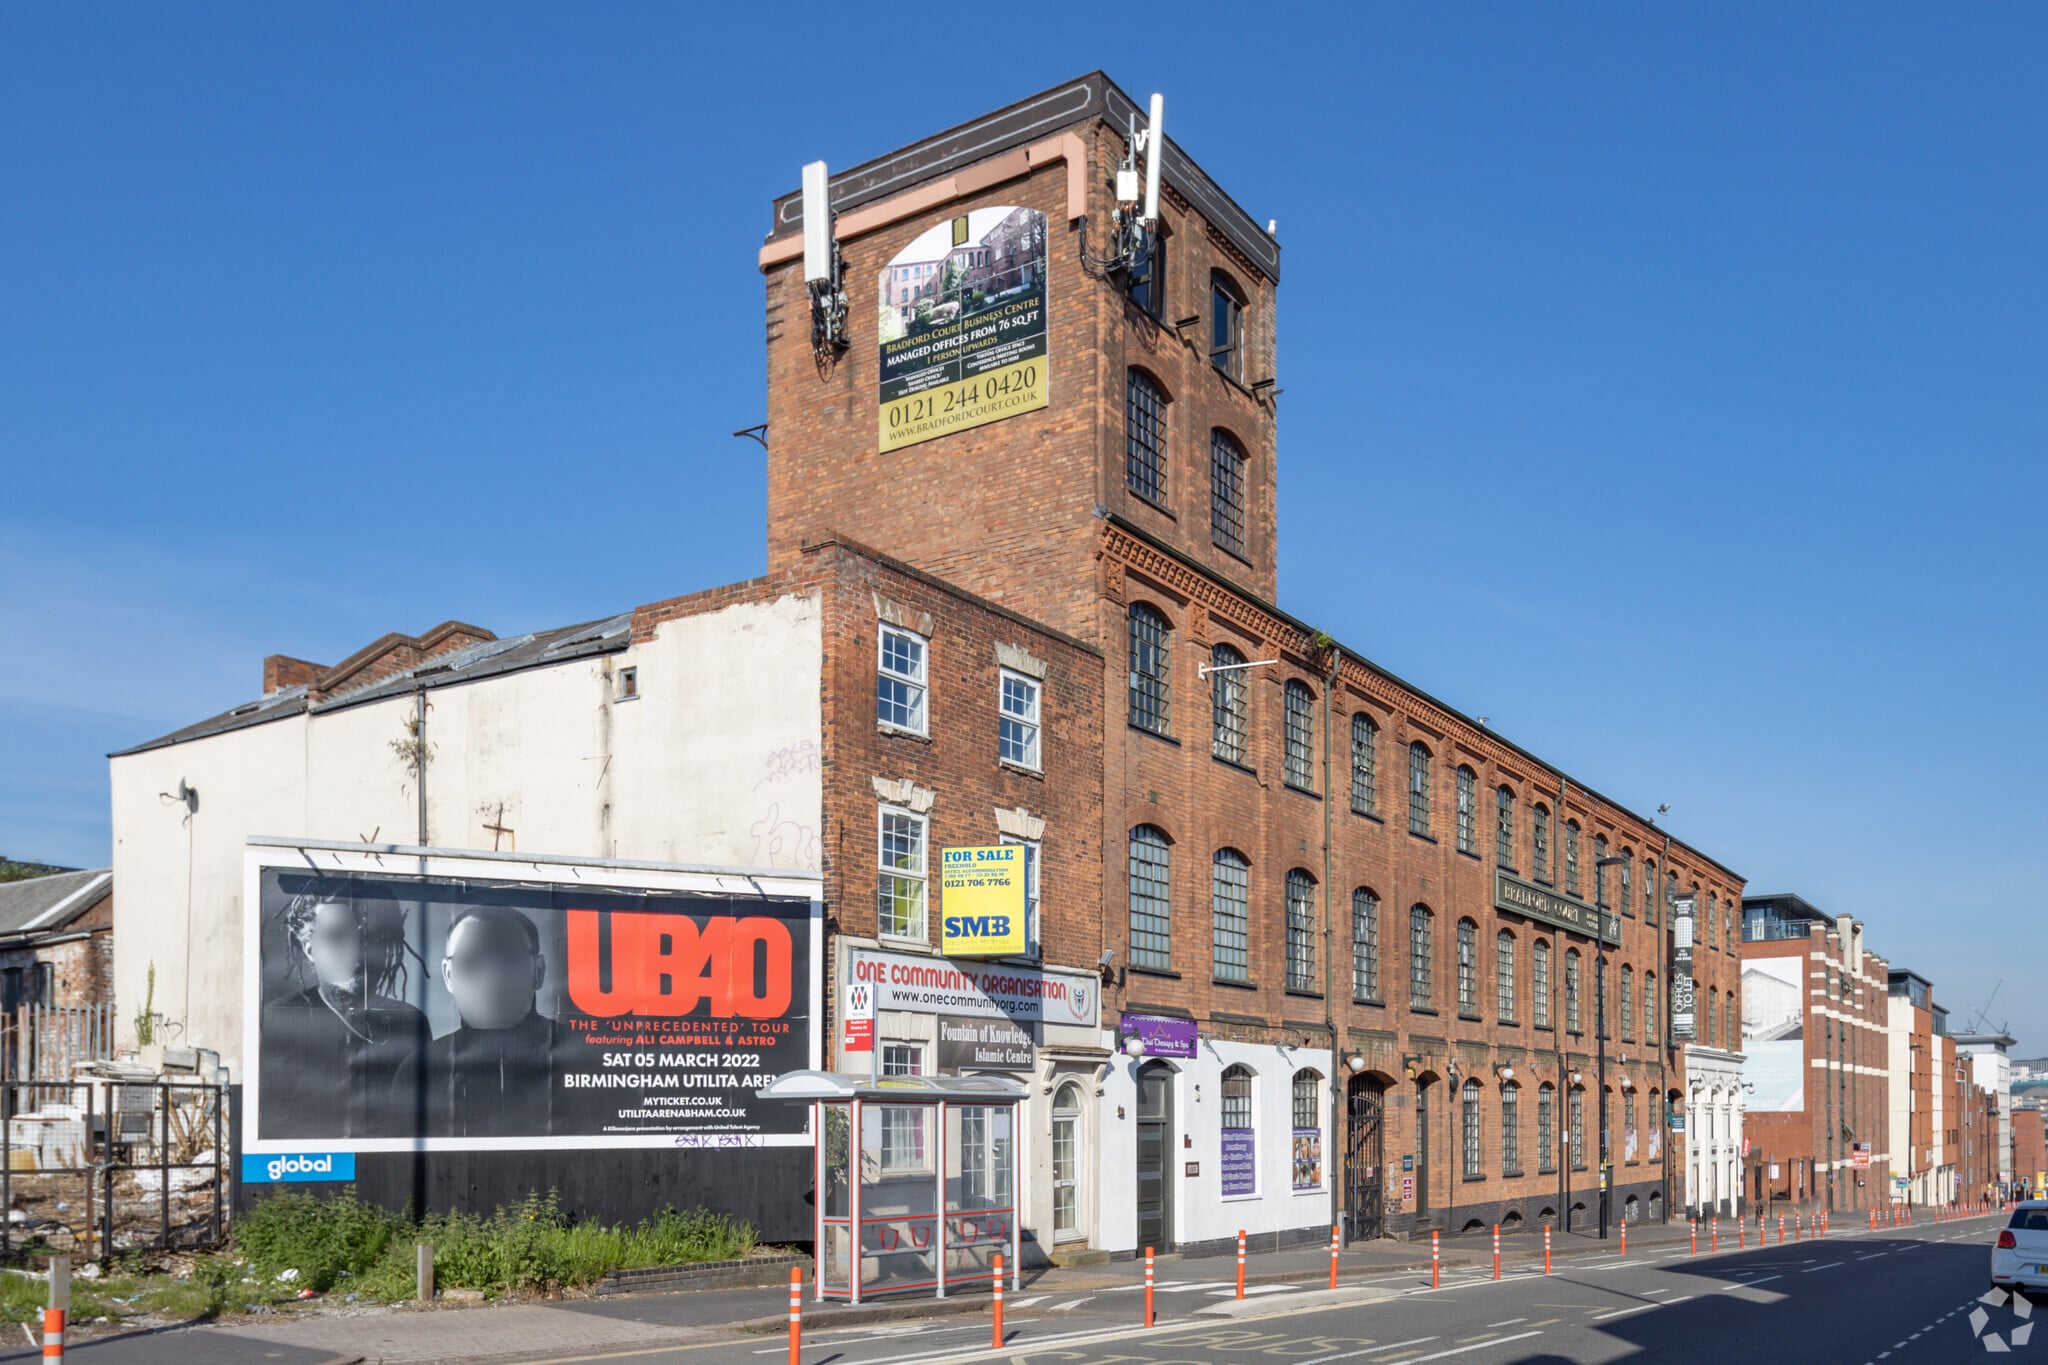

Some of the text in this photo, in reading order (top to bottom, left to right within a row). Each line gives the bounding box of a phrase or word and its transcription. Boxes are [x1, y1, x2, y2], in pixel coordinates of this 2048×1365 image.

[886, 297, 1040, 354] BRADFORD COURT BUSINESS CENTRE
[887, 345, 931, 367] MANAGED
[932, 333, 969, 352] OFFICES
[970, 324, 997, 340] FROM
[998, 319, 1010, 331] 76
[1027, 310, 1039, 322] FT
[933, 349, 961, 362] PERSON
[962, 336, 998, 353] UPWARDS
[889, 366, 1037, 428] 0121 244 0420
[889, 392, 1037, 441] WWW.BRADFORDCOURT.CO.UK
[944, 849, 1014, 862] FOR SALE
[944, 878, 1011, 888] 0121 706 7766
[1554, 902, 1579, 924] COURT
[945, 916, 1011, 938] SMB
[567, 909, 792, 1020] UB40
[856, 960, 887, 984] ONE
[891, 964, 978, 993] COMMUNITY
[981, 974, 1067, 1001] ORGANISATION
[1675, 973, 1683, 1012] OFFICES
[1684, 976, 1692, 1008] TO LET
[892, 989, 1039, 1013] www.onecommunityorg.com
[569, 1019, 598, 1031] THE
[752, 1022, 790, 1034] TOUR
[940, 1021, 1032, 1046] Fountain of Knowledge
[585, 1033, 776, 1047] featuring ALI CAMPBELL & ASTRO
[603, 1053, 760, 1068] SAT 05 MARCH 2022
[975, 1048, 1032, 1064] Islamic Centre
[564, 1074, 679, 1088] BIRMINGHAM
[683, 1074, 738, 1088] UTILITA
[643, 1096, 722, 1106] MYTICKET.CO.UK
[618, 1108, 746, 1119] UTILITAARENABHAM.CO.UK
[267, 1154, 332, 1180] global
[1141, 1330, 1377, 1355] BUS
